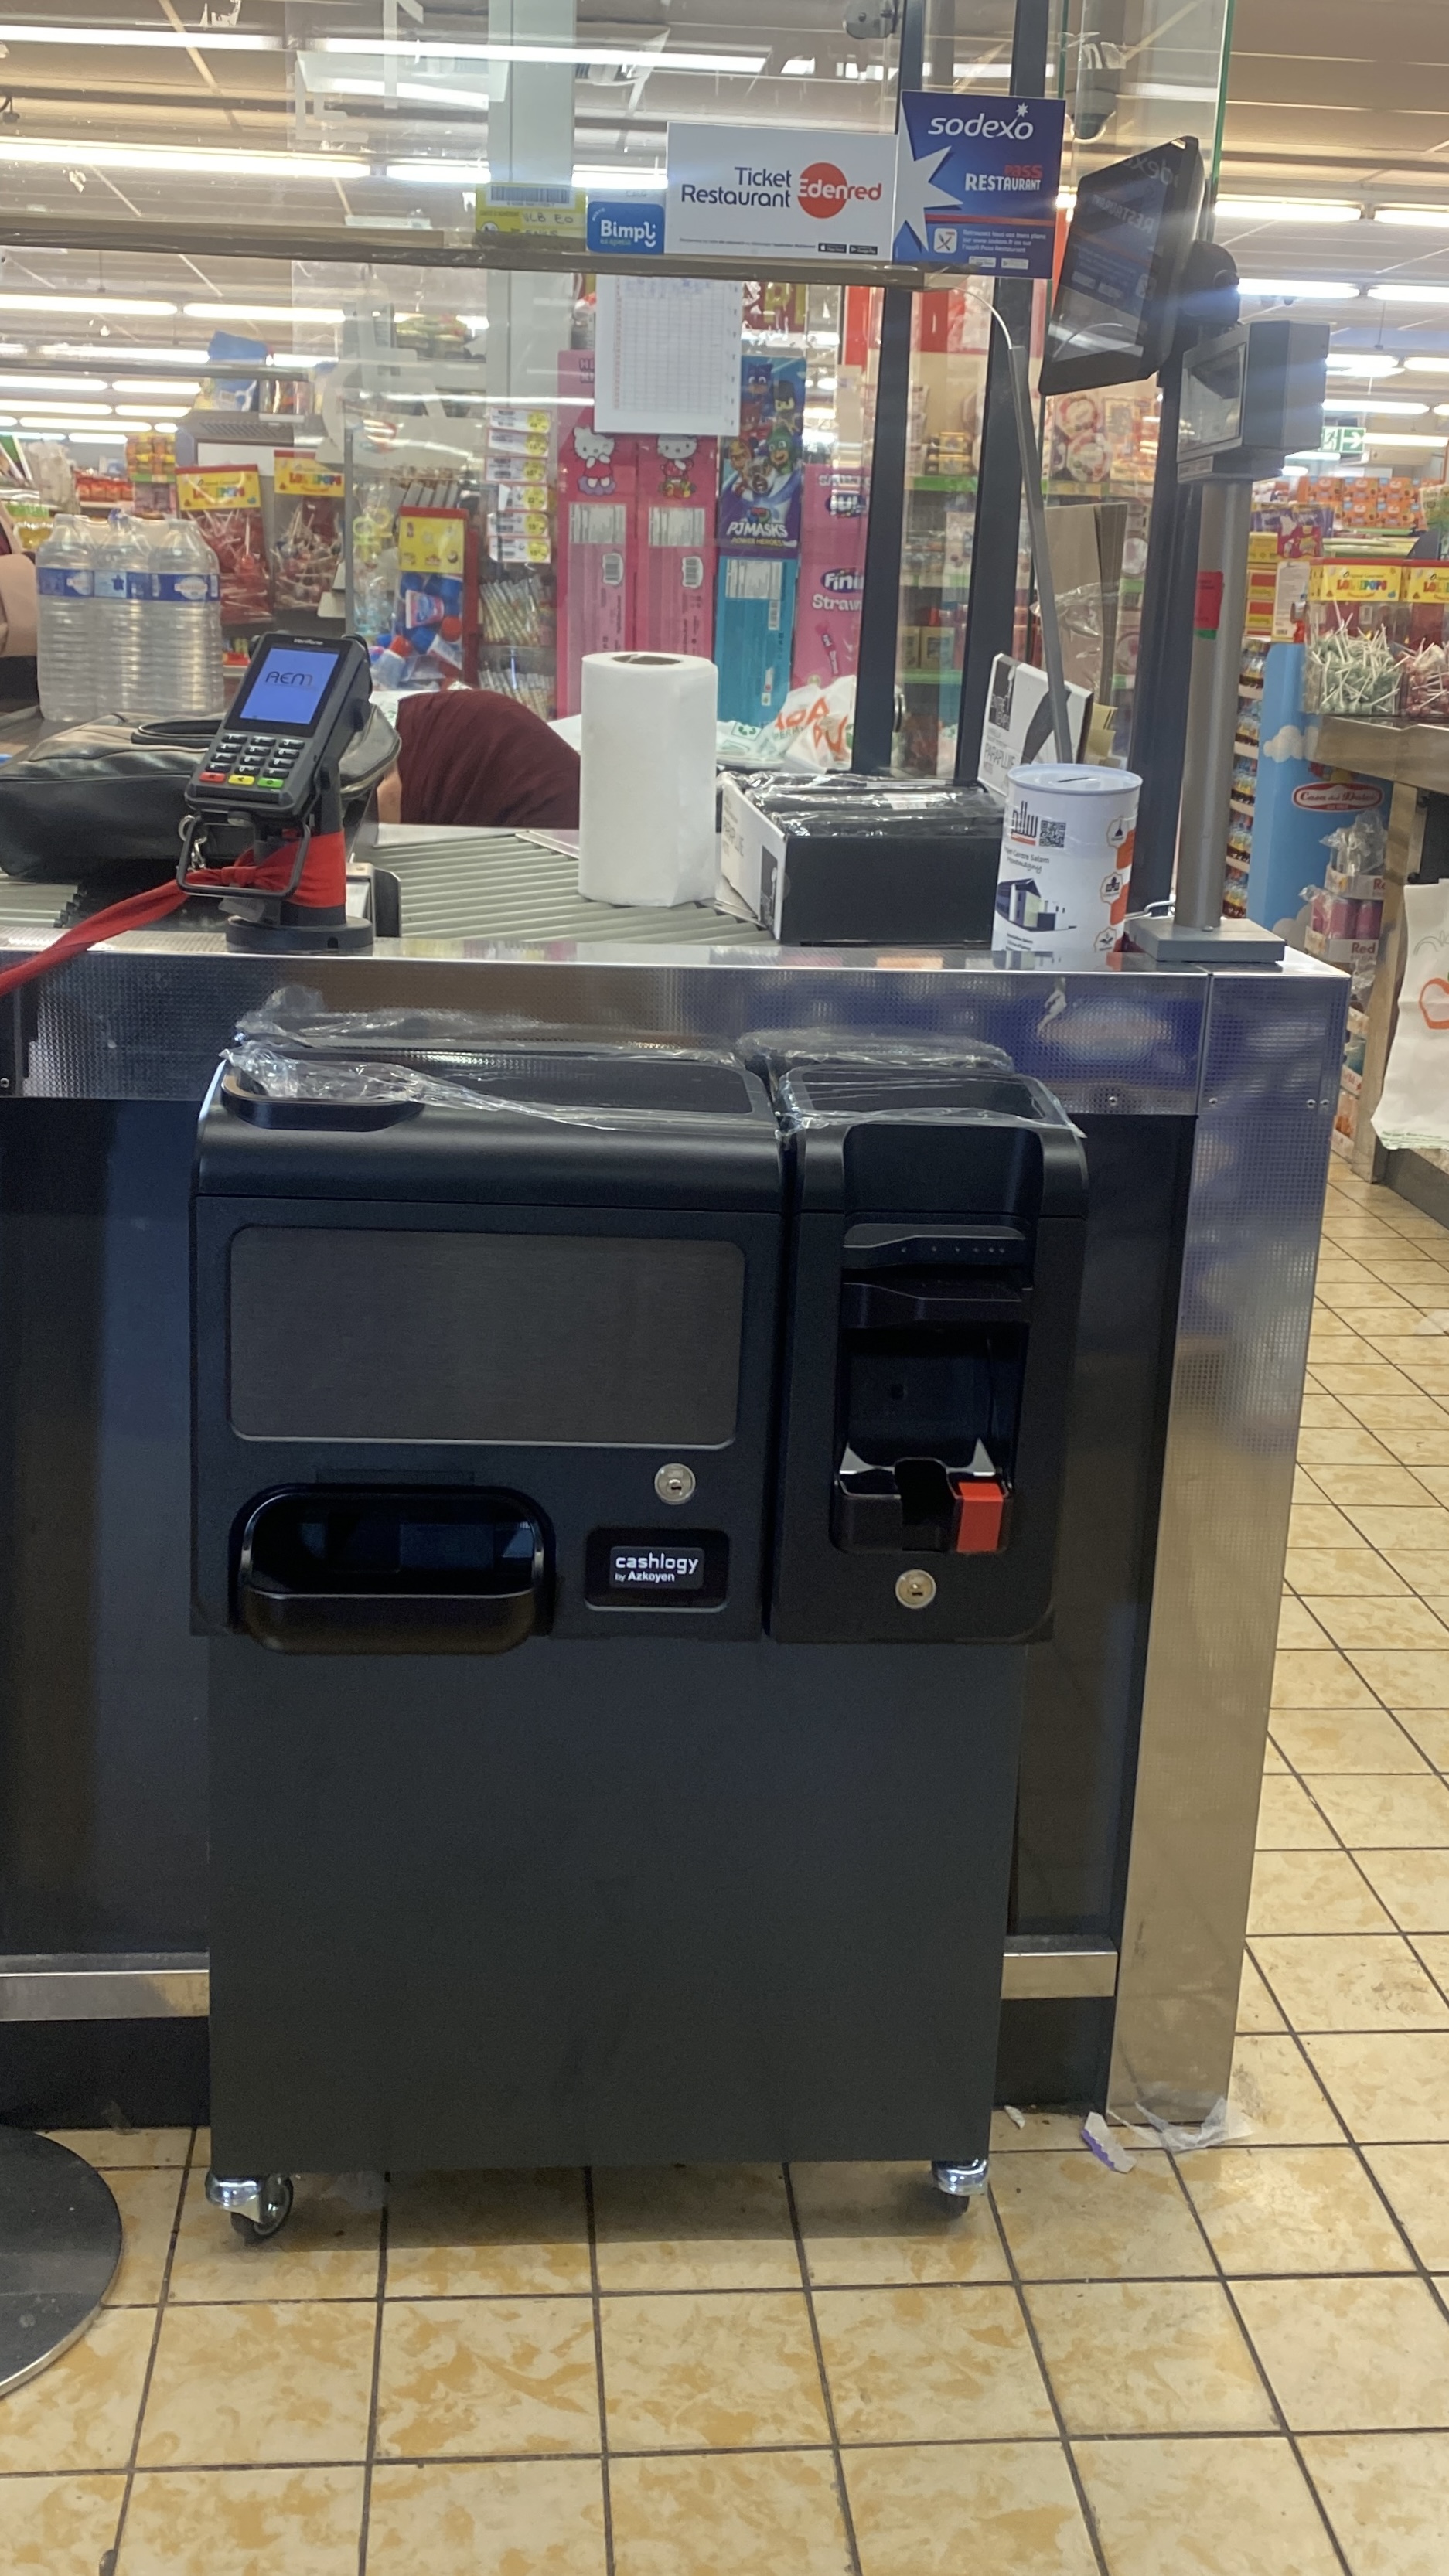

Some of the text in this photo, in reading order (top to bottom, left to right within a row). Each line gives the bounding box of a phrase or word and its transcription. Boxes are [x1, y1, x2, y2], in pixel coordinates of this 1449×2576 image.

[928, 113, 1034, 140] sodexo
[734, 166, 792, 188] Ticket
[965, 173, 1041, 192] RESTAURANT
[681, 184, 791, 208] Restaurant
[798, 179, 882, 201] Edenred
[600, 220, 656, 243] Bimpli
[1351, 942, 1376, 954] Red
[615, 1552, 699, 1575] cashlogy
[615, 1570, 675, 1583] by Azkoyen
